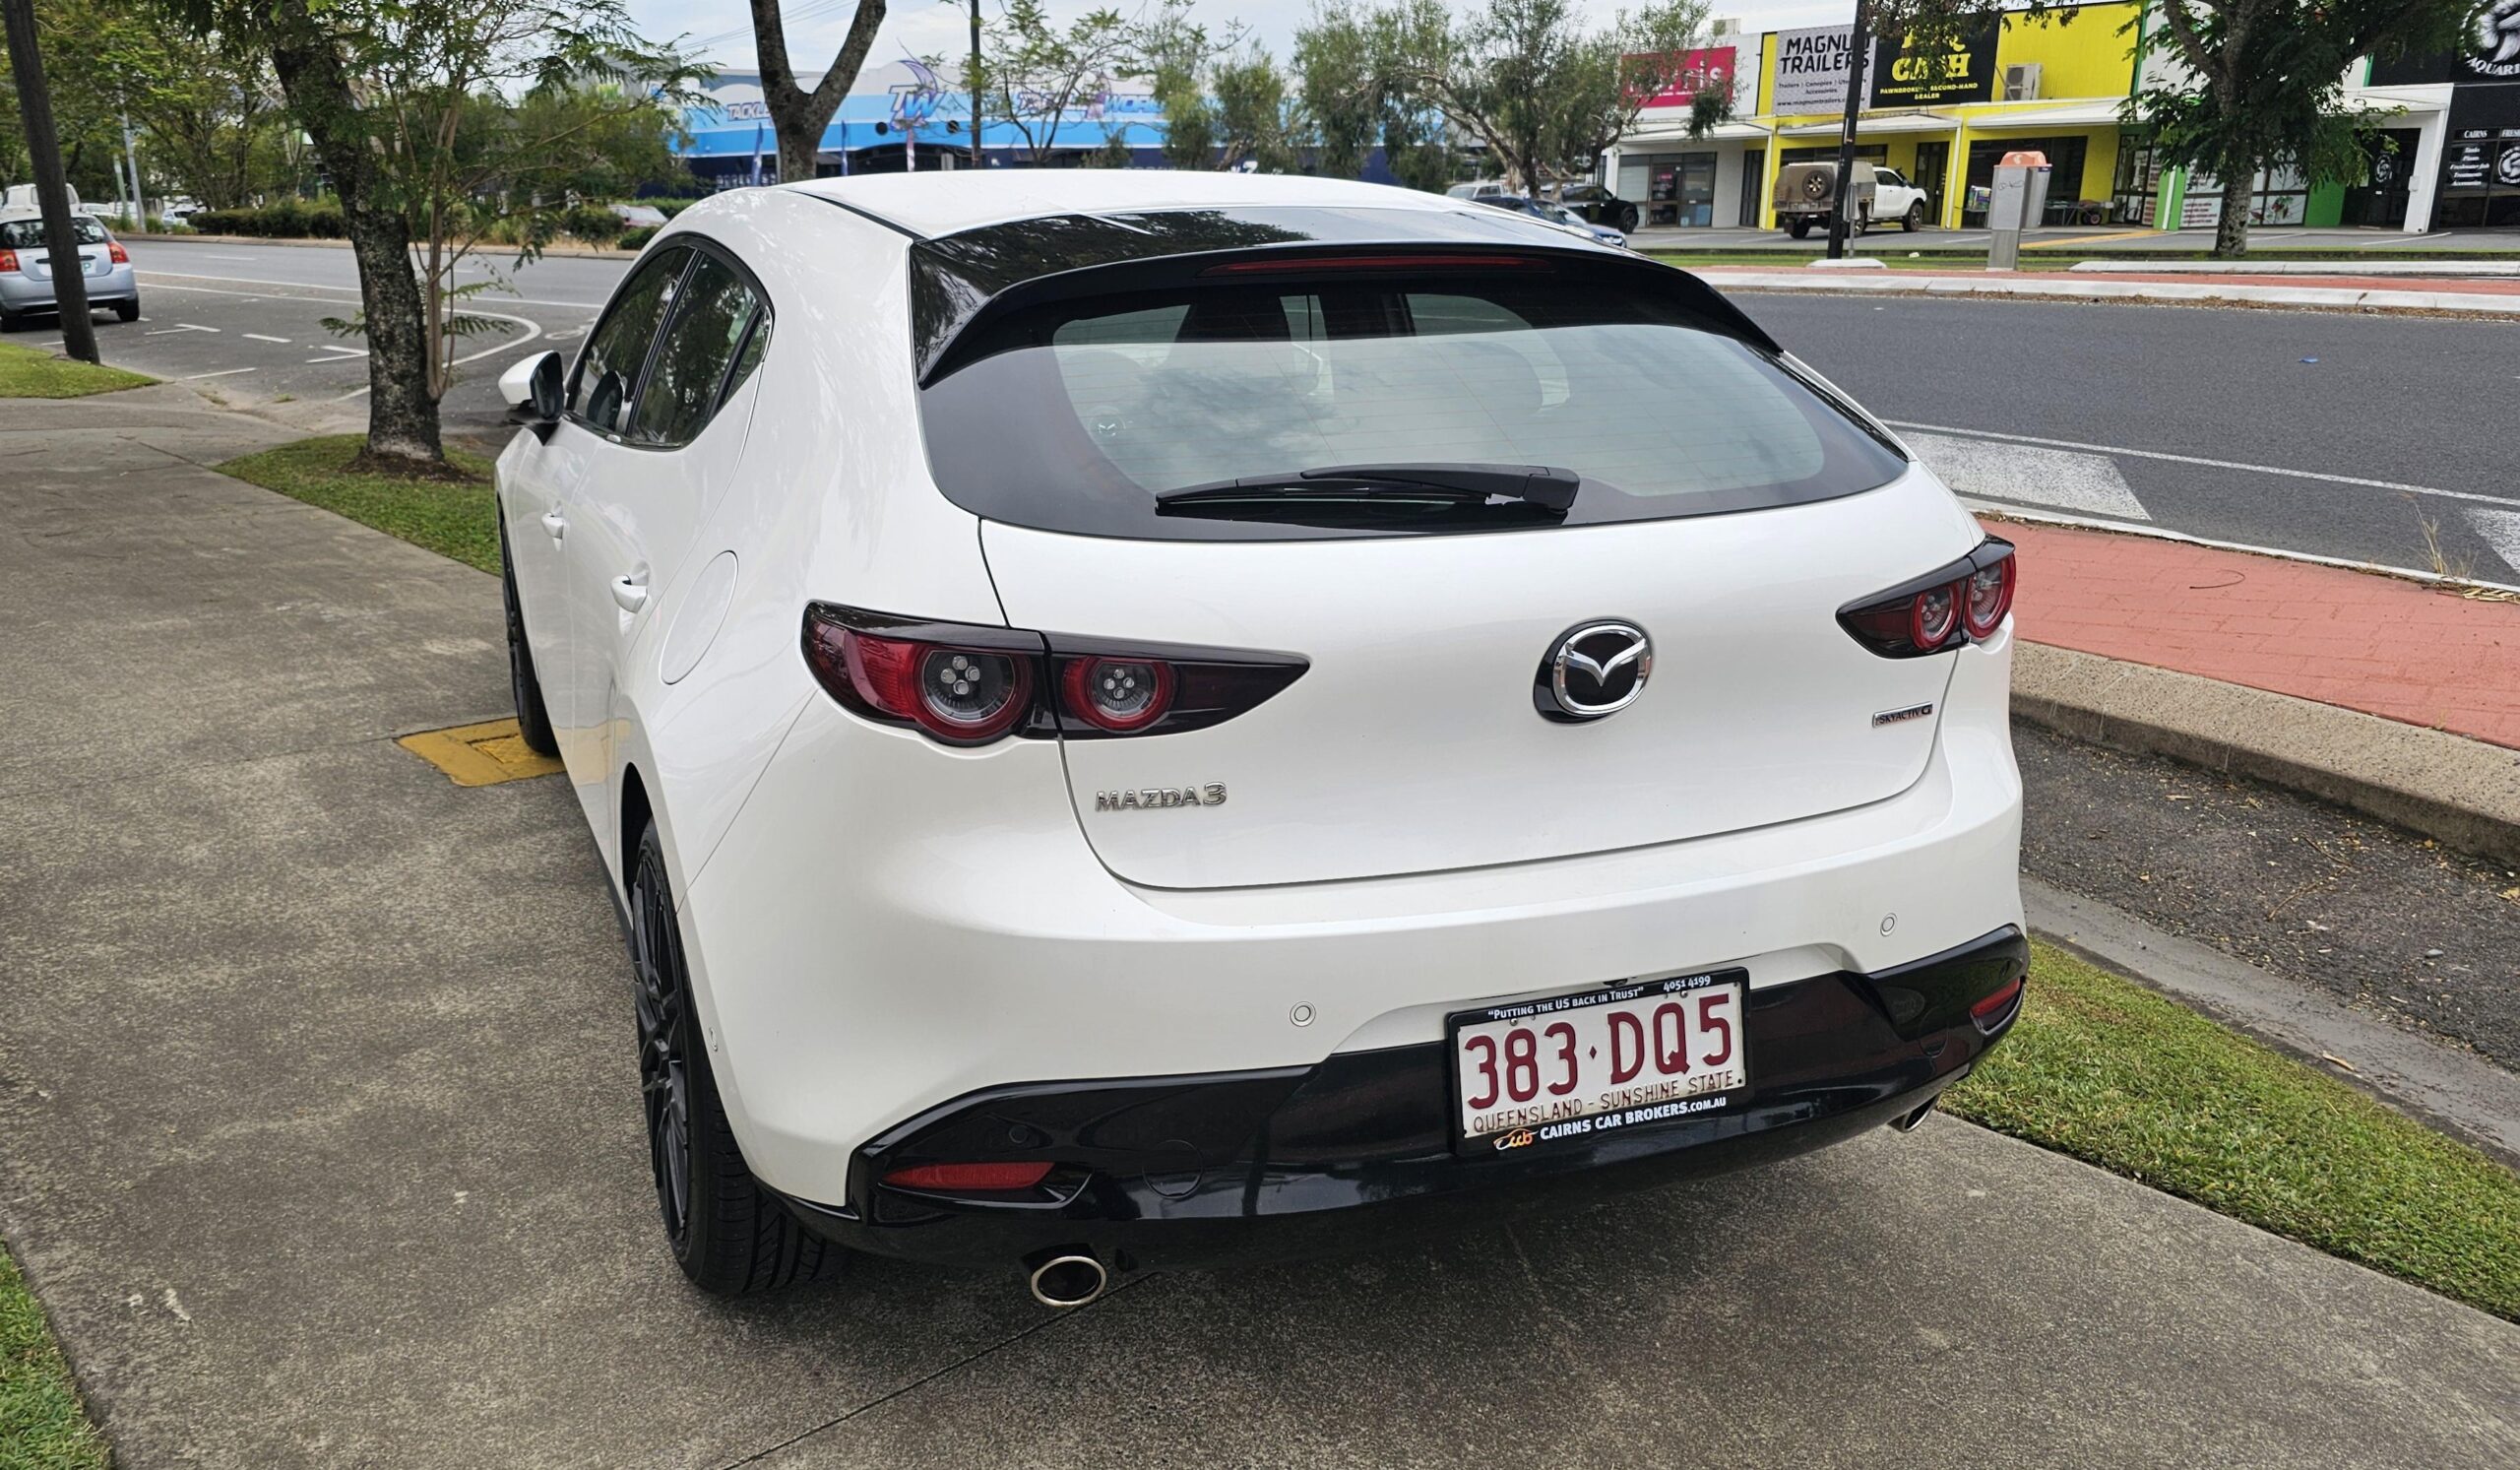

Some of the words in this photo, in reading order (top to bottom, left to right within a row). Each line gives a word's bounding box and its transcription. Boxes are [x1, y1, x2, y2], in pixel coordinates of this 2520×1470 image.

[1663, 979, 1686, 992] 4051
[1687, 975, 1712, 990] 4199
[1536, 1002, 1554, 1013] THE
[1555, 997, 1570, 1010] US
[1572, 994, 1597, 1007] BACK
[1598, 993, 1608, 1003] IN
[1474, 1098, 1584, 1133] QUEENSLAND
[1600, 1079, 1679, 1110] SUNSHINE
[1688, 1069, 1734, 1095] STATE
[1540, 1118, 1592, 1140] CAIRNS
[1595, 1110, 1622, 1129] CAR
[1624, 1096, 1727, 1124] BROKERS.COM.AU
